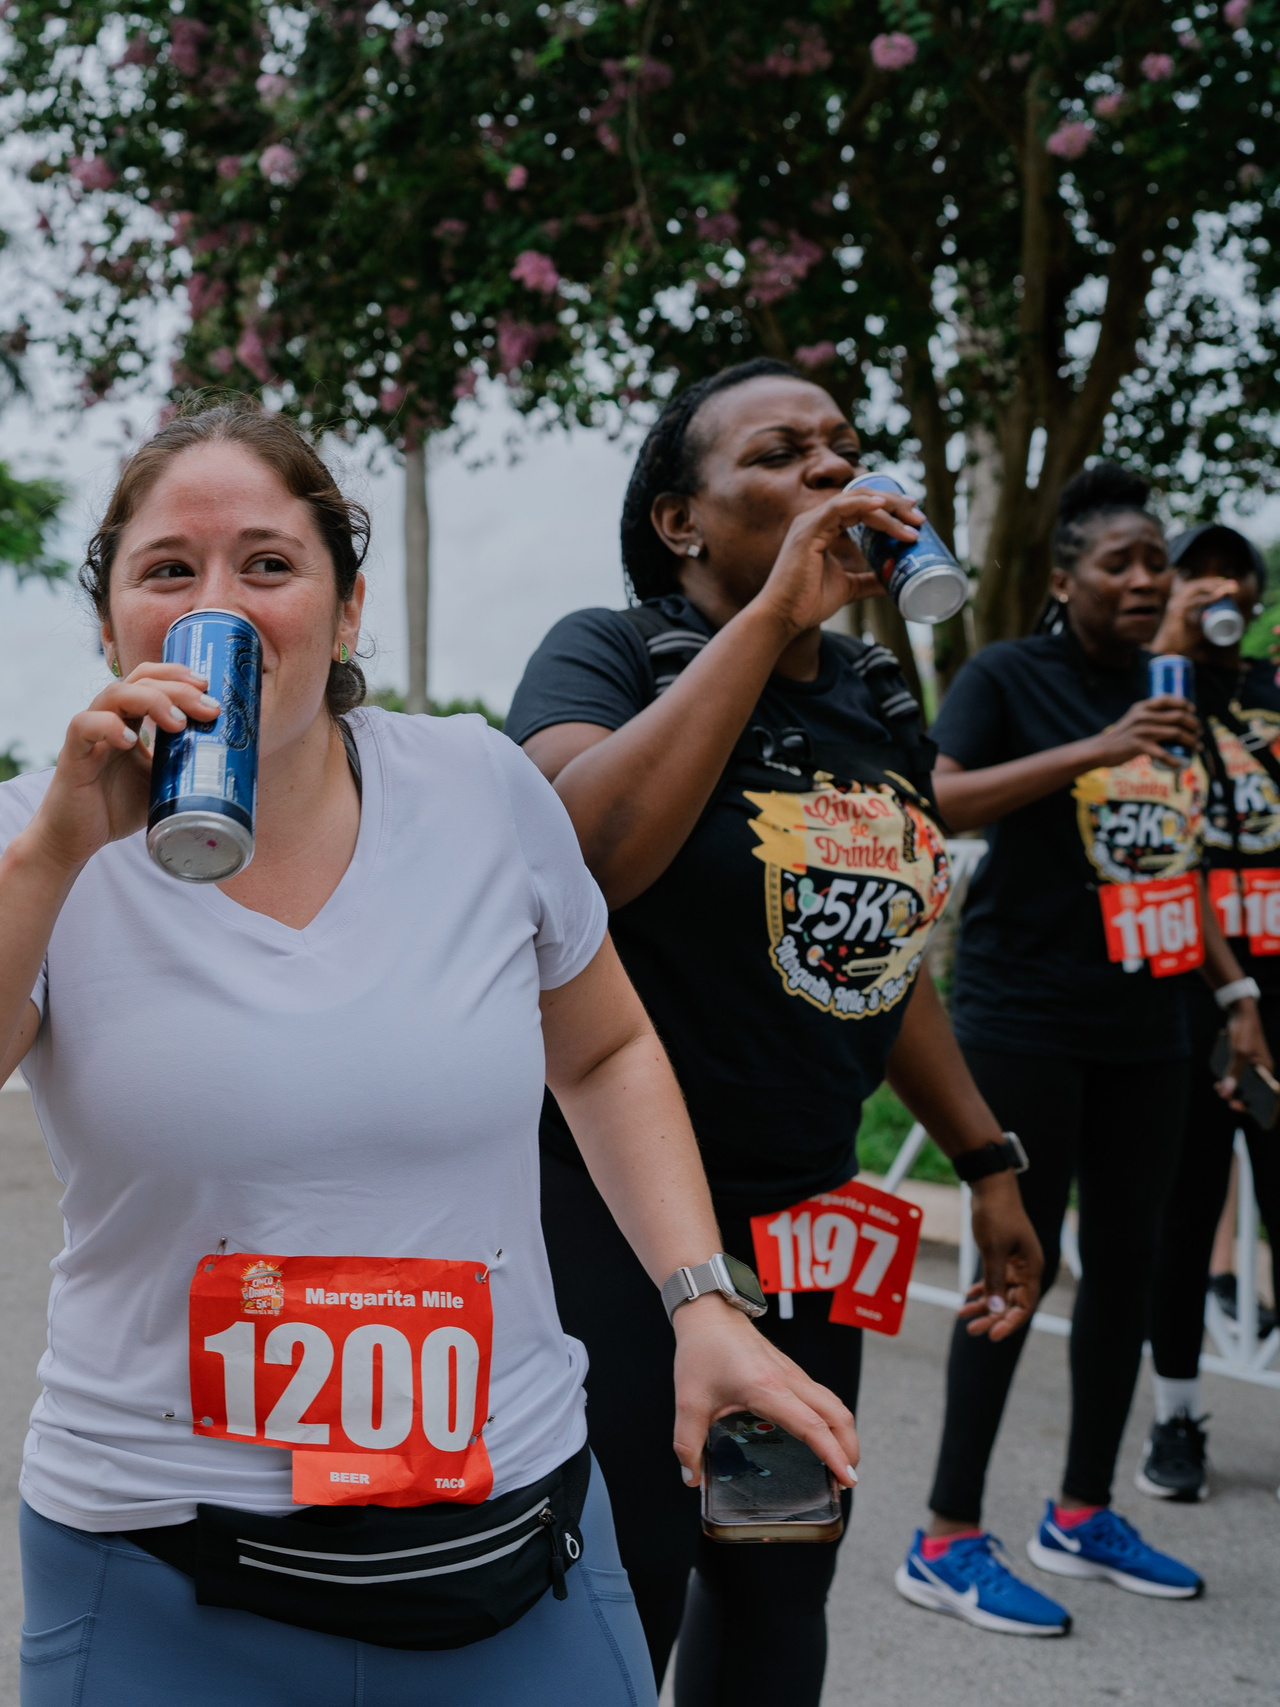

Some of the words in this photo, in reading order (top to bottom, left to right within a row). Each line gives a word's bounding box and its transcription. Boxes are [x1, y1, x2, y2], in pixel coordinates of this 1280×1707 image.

[1113, 803, 1165, 848] 5K
[815, 836, 901, 872] Drinko
[811, 879, 897, 941] 5K
[767, 1211, 899, 1297] 1197
[304, 1287, 417, 1310] Margarita
[421, 1290, 465, 1309] Mile
[203, 1321, 480, 1452] 1200
[329, 1471, 370, 1485] BEER
[434, 1477, 466, 1489] TACO
